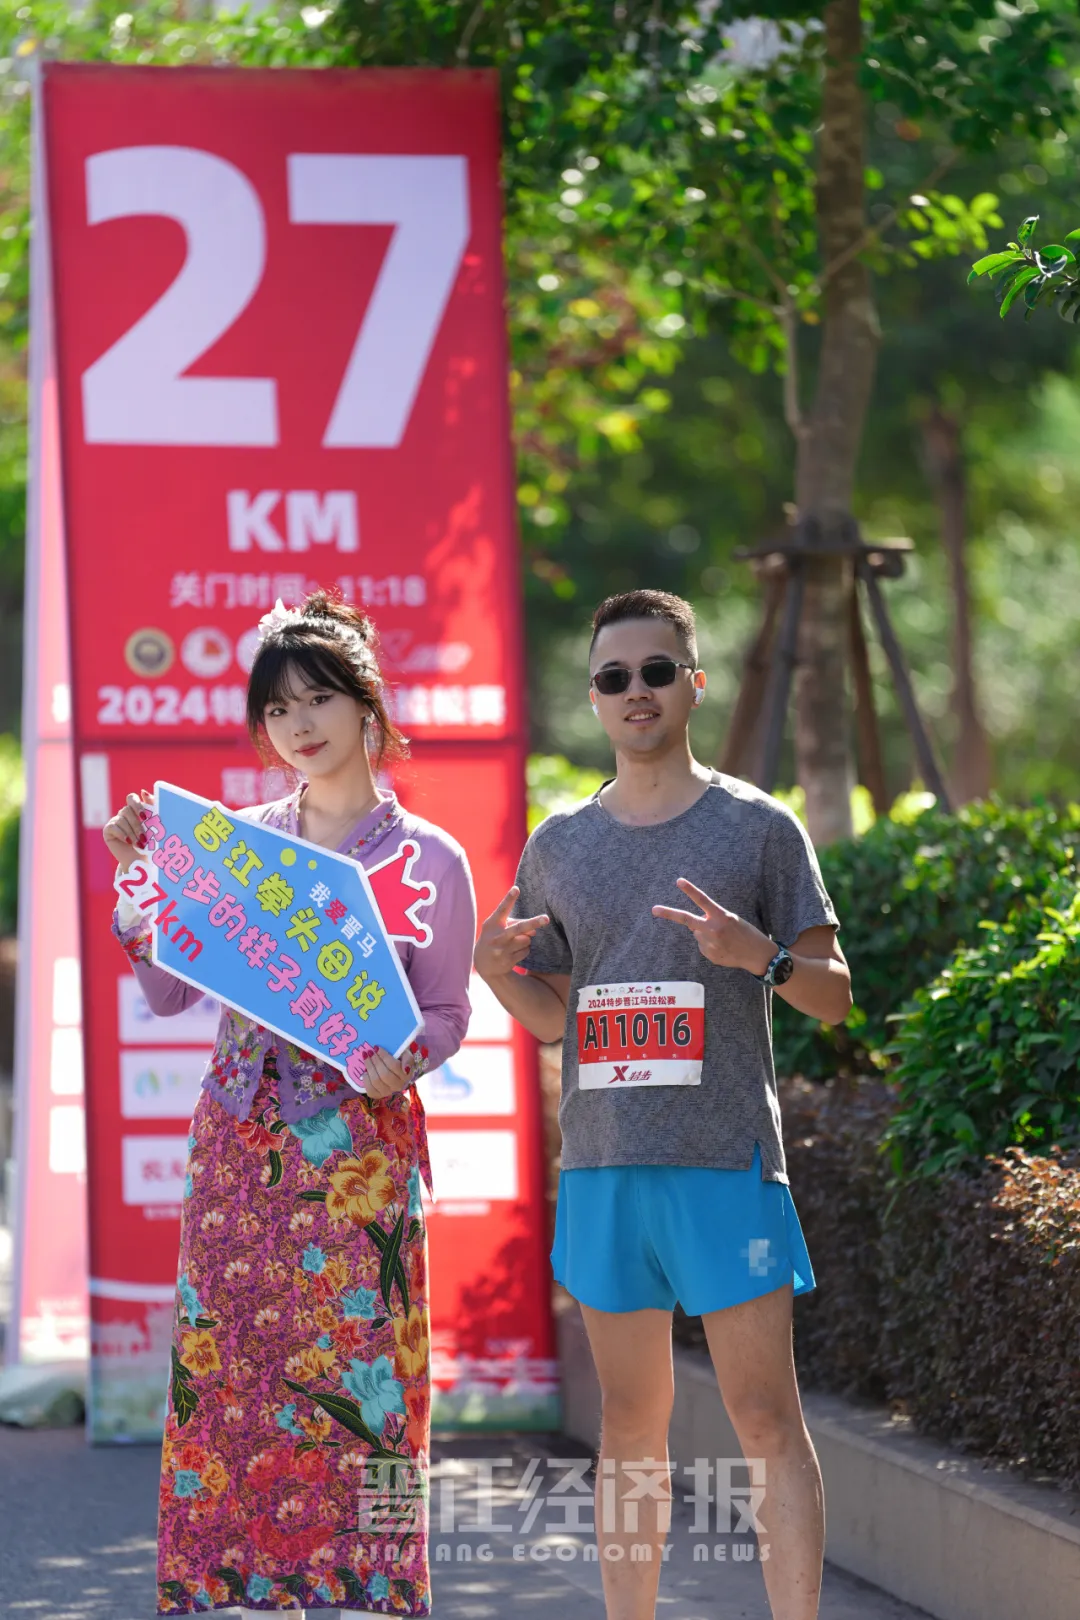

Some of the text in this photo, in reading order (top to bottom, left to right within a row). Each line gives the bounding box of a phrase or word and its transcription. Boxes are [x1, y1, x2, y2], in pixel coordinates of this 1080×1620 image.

[81, 144, 471, 448] 27
[226, 489, 358, 552] KM
[119, 865, 204, 963] 27km
[193, 806, 387, 1022] 晋江拳头母说
[308, 881, 378, 959] 我爱晋马
[583, 1012, 692, 1050] A11016
[588, 995, 677, 1009] 2024特步晋江马拉松赛
